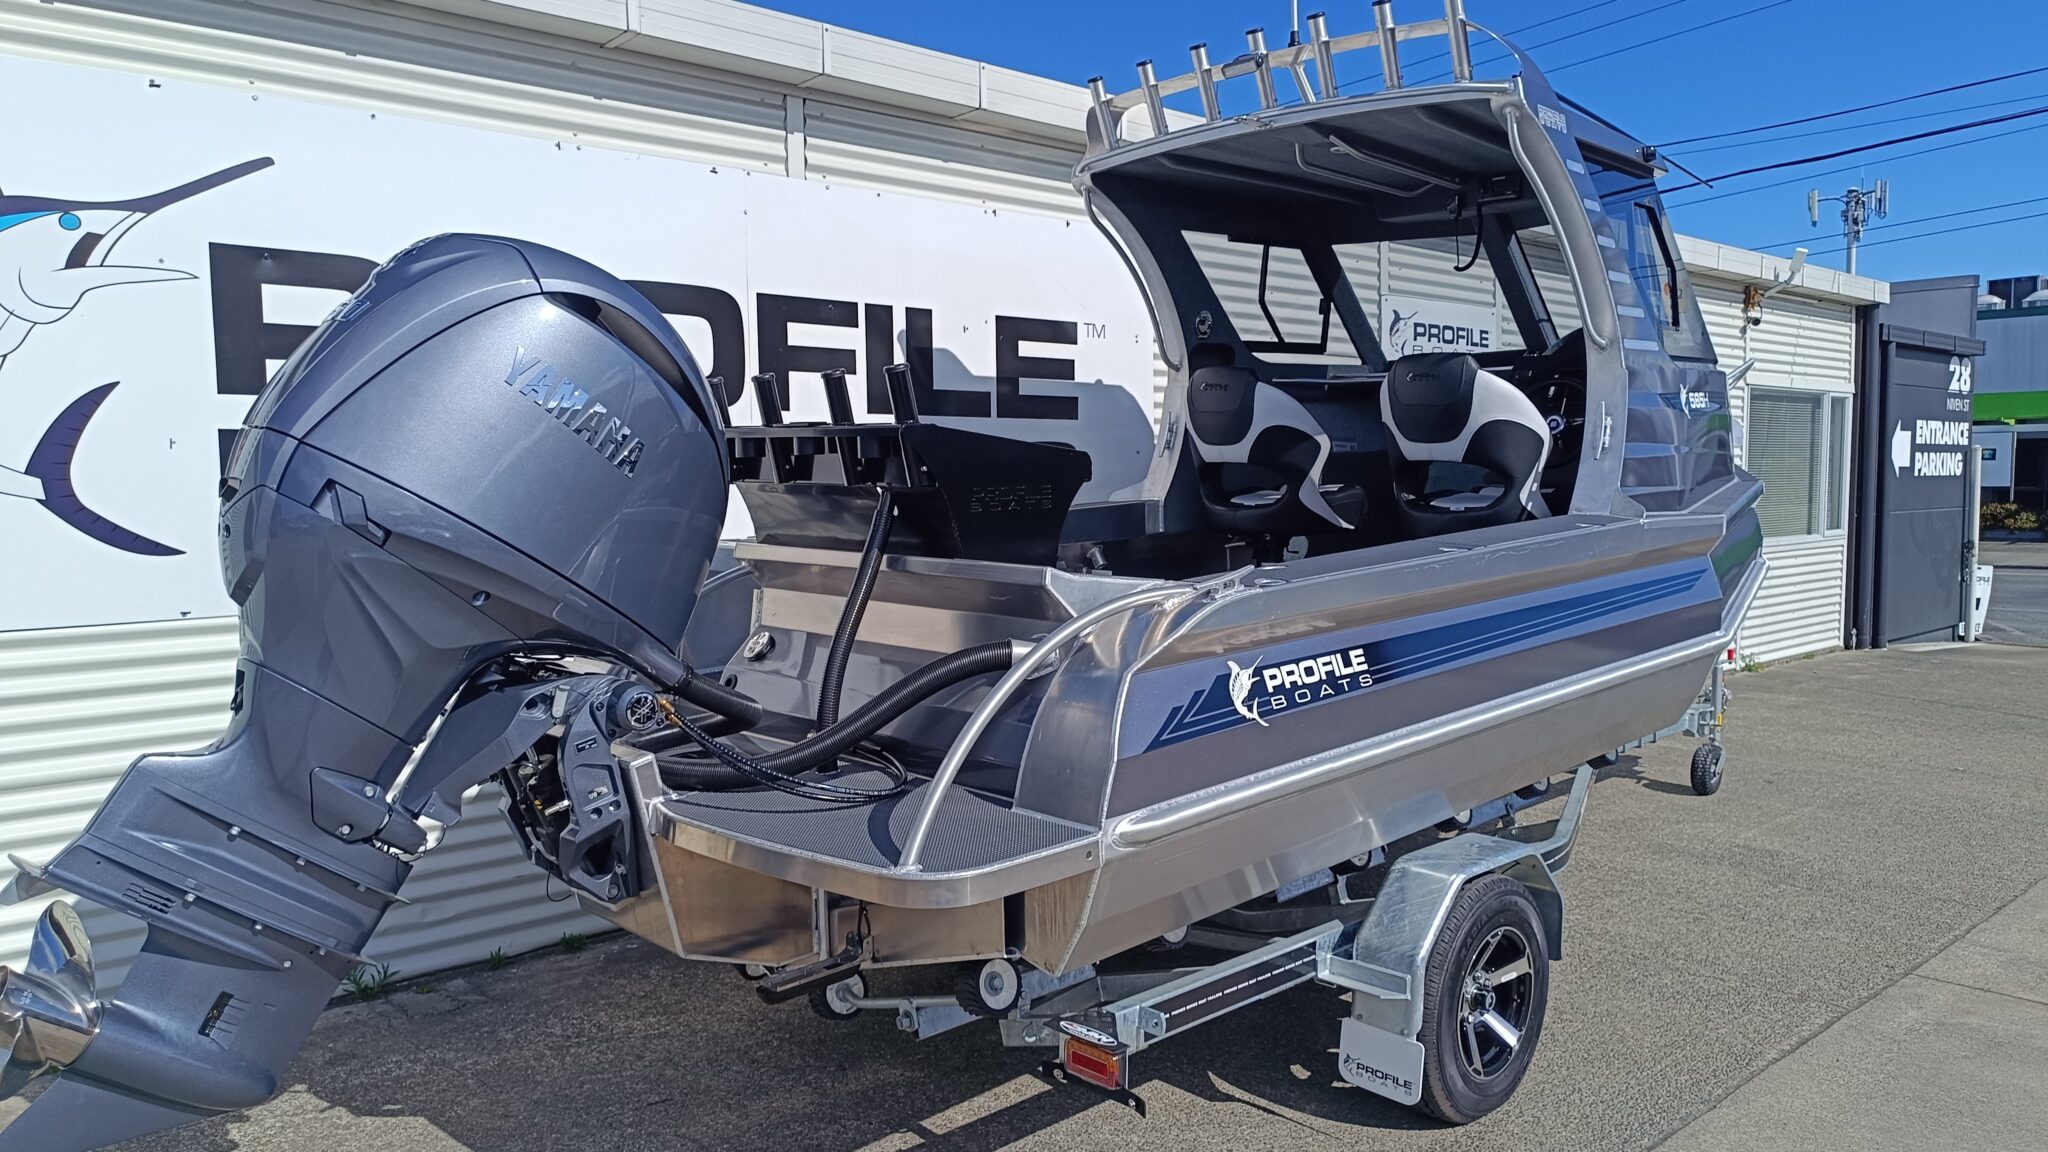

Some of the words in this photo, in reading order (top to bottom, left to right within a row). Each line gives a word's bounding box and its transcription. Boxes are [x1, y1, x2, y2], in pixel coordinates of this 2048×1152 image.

[1413, 322, 1489, 348] PROFILE
[1947, 356, 1971, 394] 28
[504, 346, 645, 479] YAMAHA
[1947, 398, 1963, 411] NIVEN
[1964, 399, 1970, 412] ST
[1915, 419, 1970, 446] ENTRANCE
[1914, 452, 1963, 476] PARKING
[1263, 648, 1369, 693] PROFILE
[1271, 673, 1373, 710] BOATS
[1356, 1070, 1412, 1096] BOATS
[1357, 1062, 1413, 1090] PROFILE
